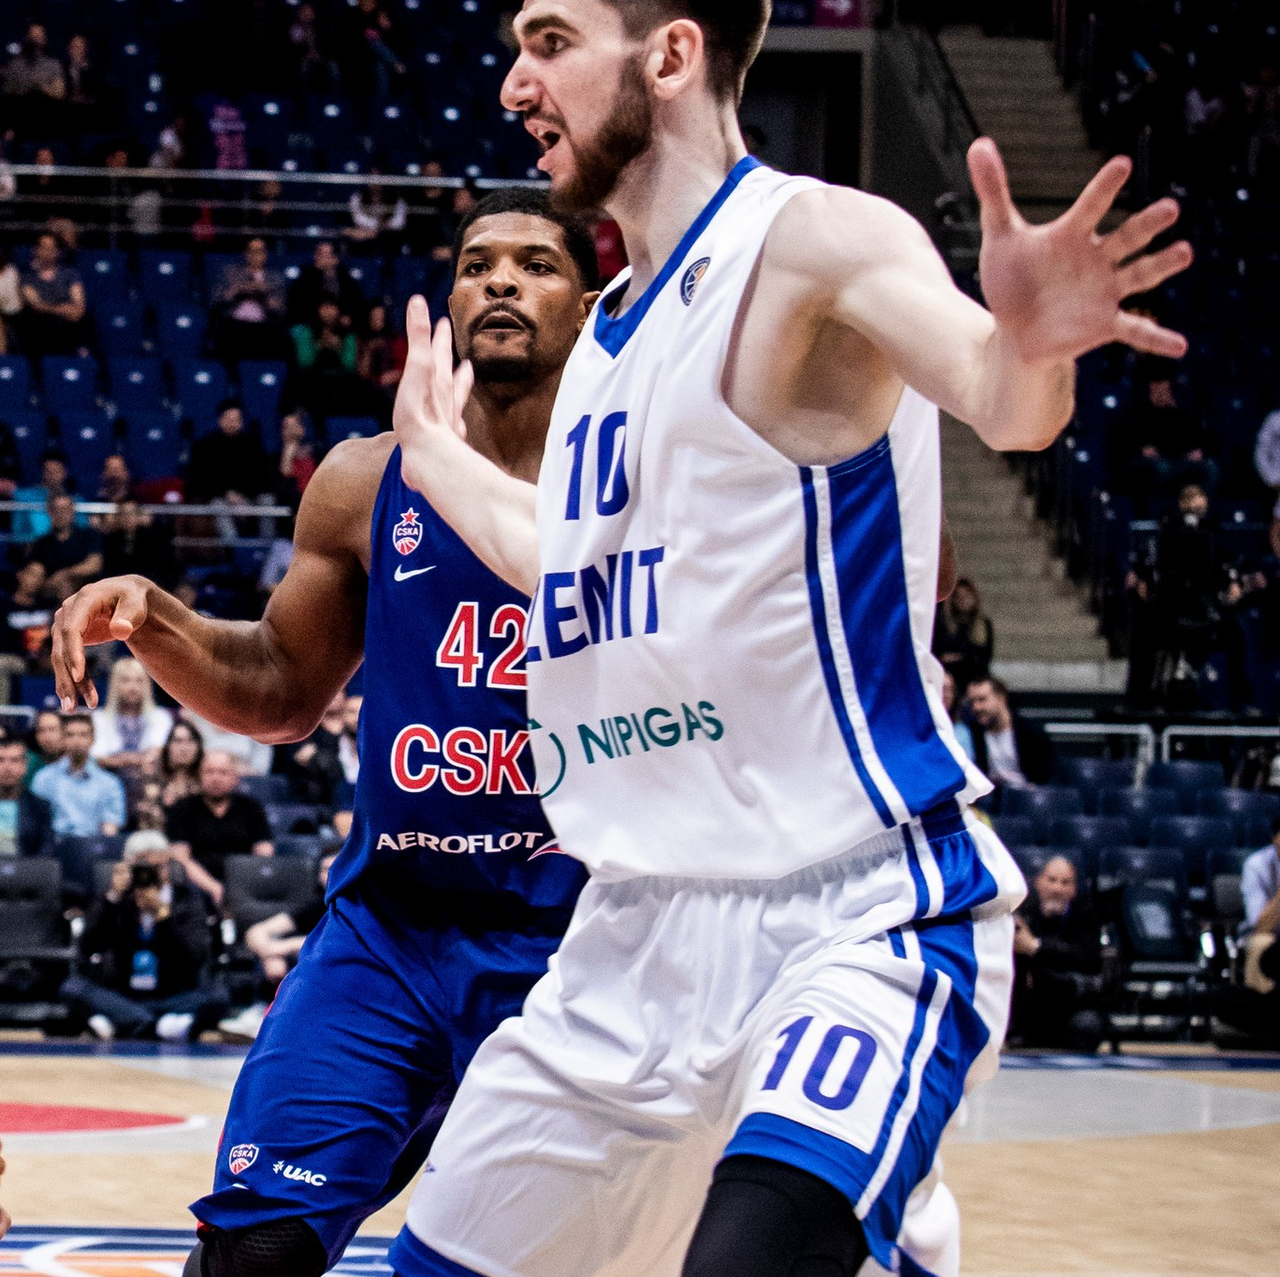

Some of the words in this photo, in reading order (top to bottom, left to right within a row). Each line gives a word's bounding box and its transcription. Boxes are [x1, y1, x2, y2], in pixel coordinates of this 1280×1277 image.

[564, 411, 630, 521] 10
[396, 527, 419, 536] CSKA
[436, 601, 532, 690] 42
[390, 723, 541, 796] CSK
[577, 700, 725, 764] NIPIGAS
[376, 831, 543, 855] AEROFLOT
[760, 1015, 877, 1111] 10
[232, 1149, 253, 1159] CSKA
[282, 1165, 327, 1187] UAC
